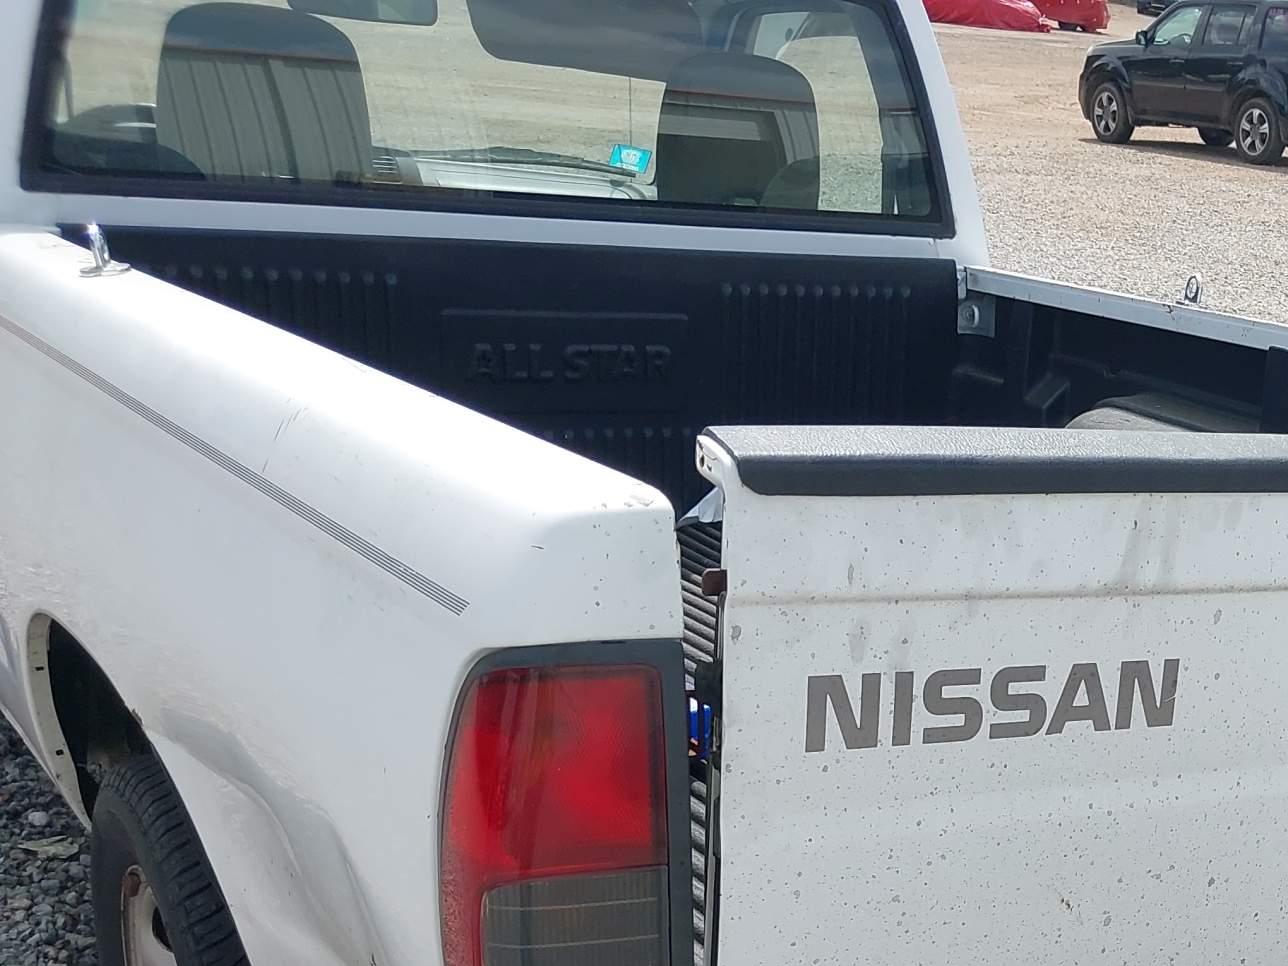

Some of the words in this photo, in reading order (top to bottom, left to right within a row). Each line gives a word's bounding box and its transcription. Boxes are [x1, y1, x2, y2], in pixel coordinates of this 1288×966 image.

[466, 343, 554, 383] ALL
[563, 344, 673, 382] STAR
[805, 658, 1180, 753] NISSAN
